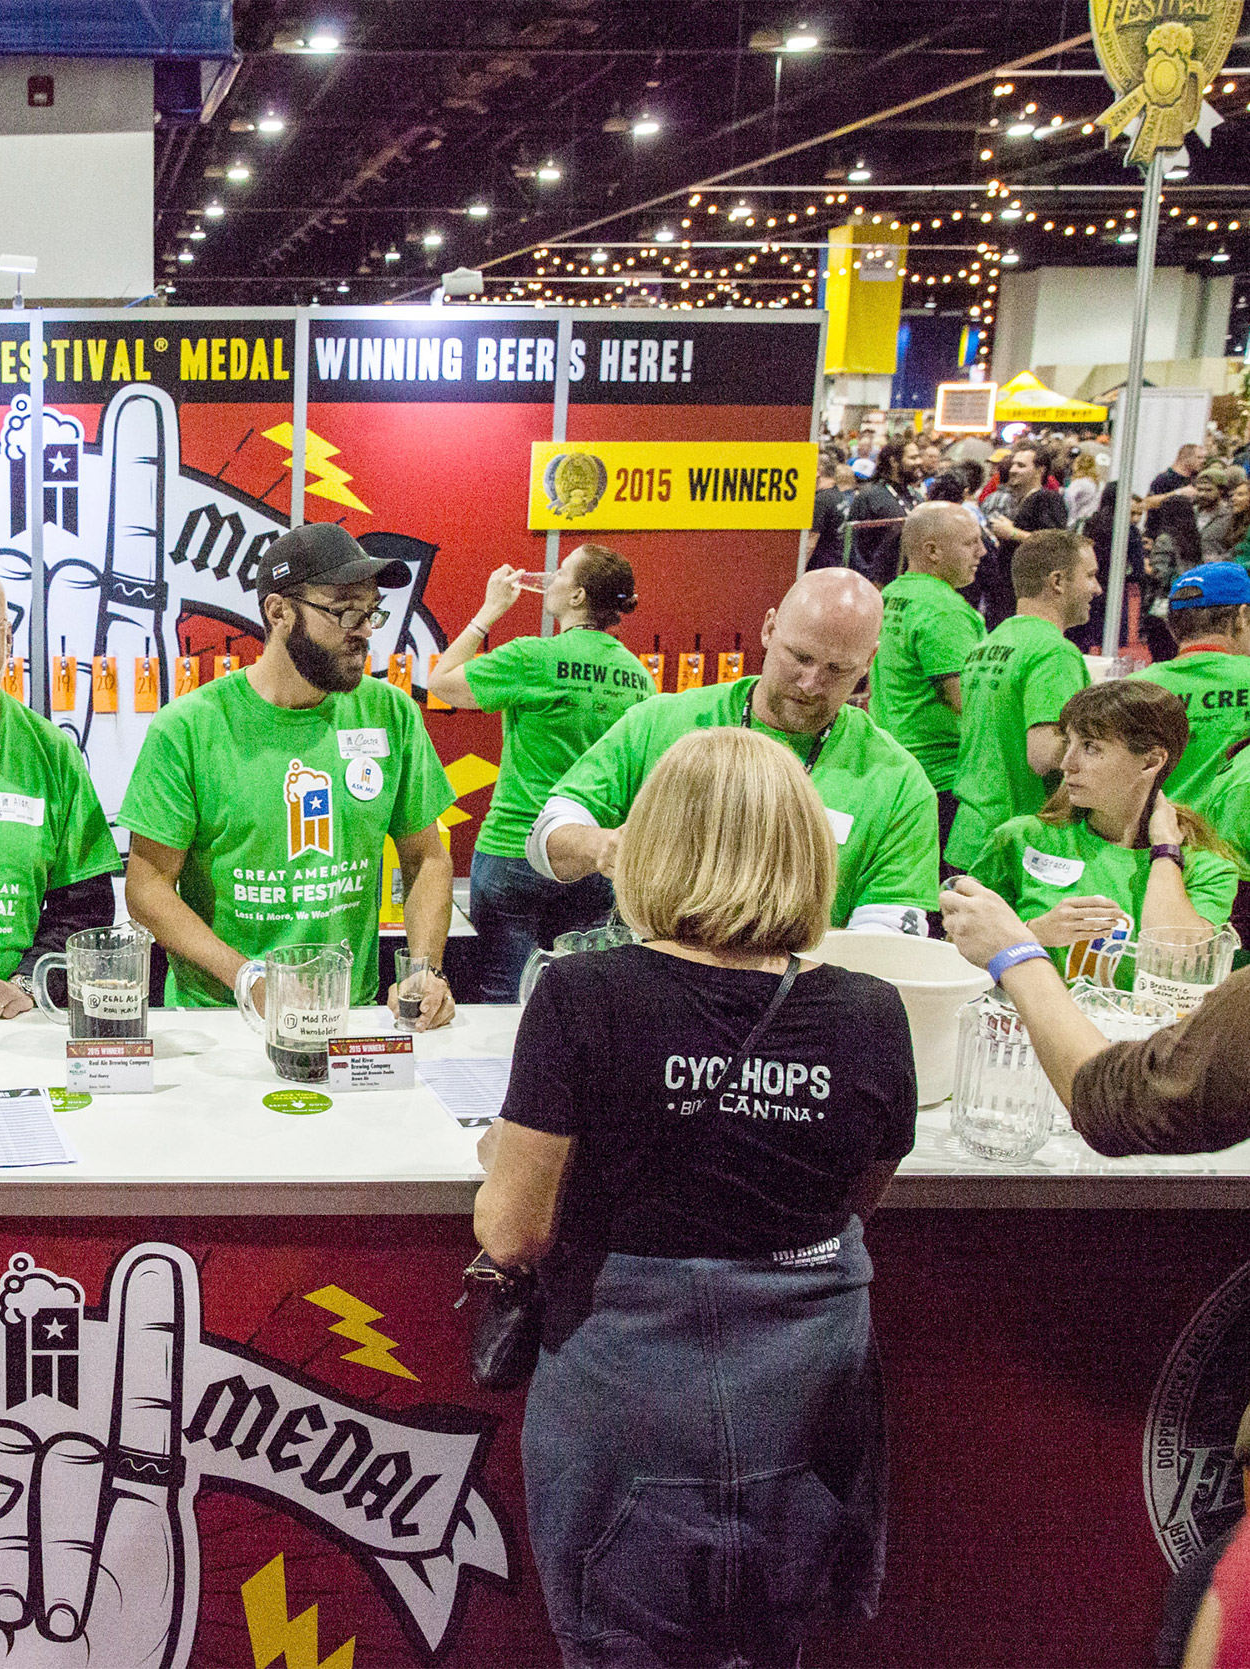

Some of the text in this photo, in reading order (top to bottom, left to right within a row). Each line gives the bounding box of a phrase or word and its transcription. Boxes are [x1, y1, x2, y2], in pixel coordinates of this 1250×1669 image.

[180, 335, 291, 382] MEDAL
[315, 335, 464, 383] WINNING
[476, 336, 587, 384] BEERS
[599, 338, 694, 384] HERE!
[614, 467, 799, 502] 2015 WINNERS
[57, 674, 71, 693] 19
[557, 661, 648, 691] BREW CREW
[137, 677, 154, 694] 21
[1202, 688, 1250, 710] CRE
[351, 783, 365, 791] ASK
[233, 867, 292, 882] GREAT
[233, 883, 286, 904] BEER
[234, 908, 253, 920] Less
[266, 910, 294, 922] More,
[295, 909, 310, 921] We
[1149, 980, 1190, 994] Brasserie
[102, 994, 139, 1003] REAL ALE
[302, 1013, 342, 1024] Mad River
[87, 1047, 125, 1056] 2015 WINNERS
[348, 1043, 386, 1054] 2015 WINNERS
[719, 1092, 812, 1123] CANTINA
[182, 1373, 444, 1537] MEDAL
